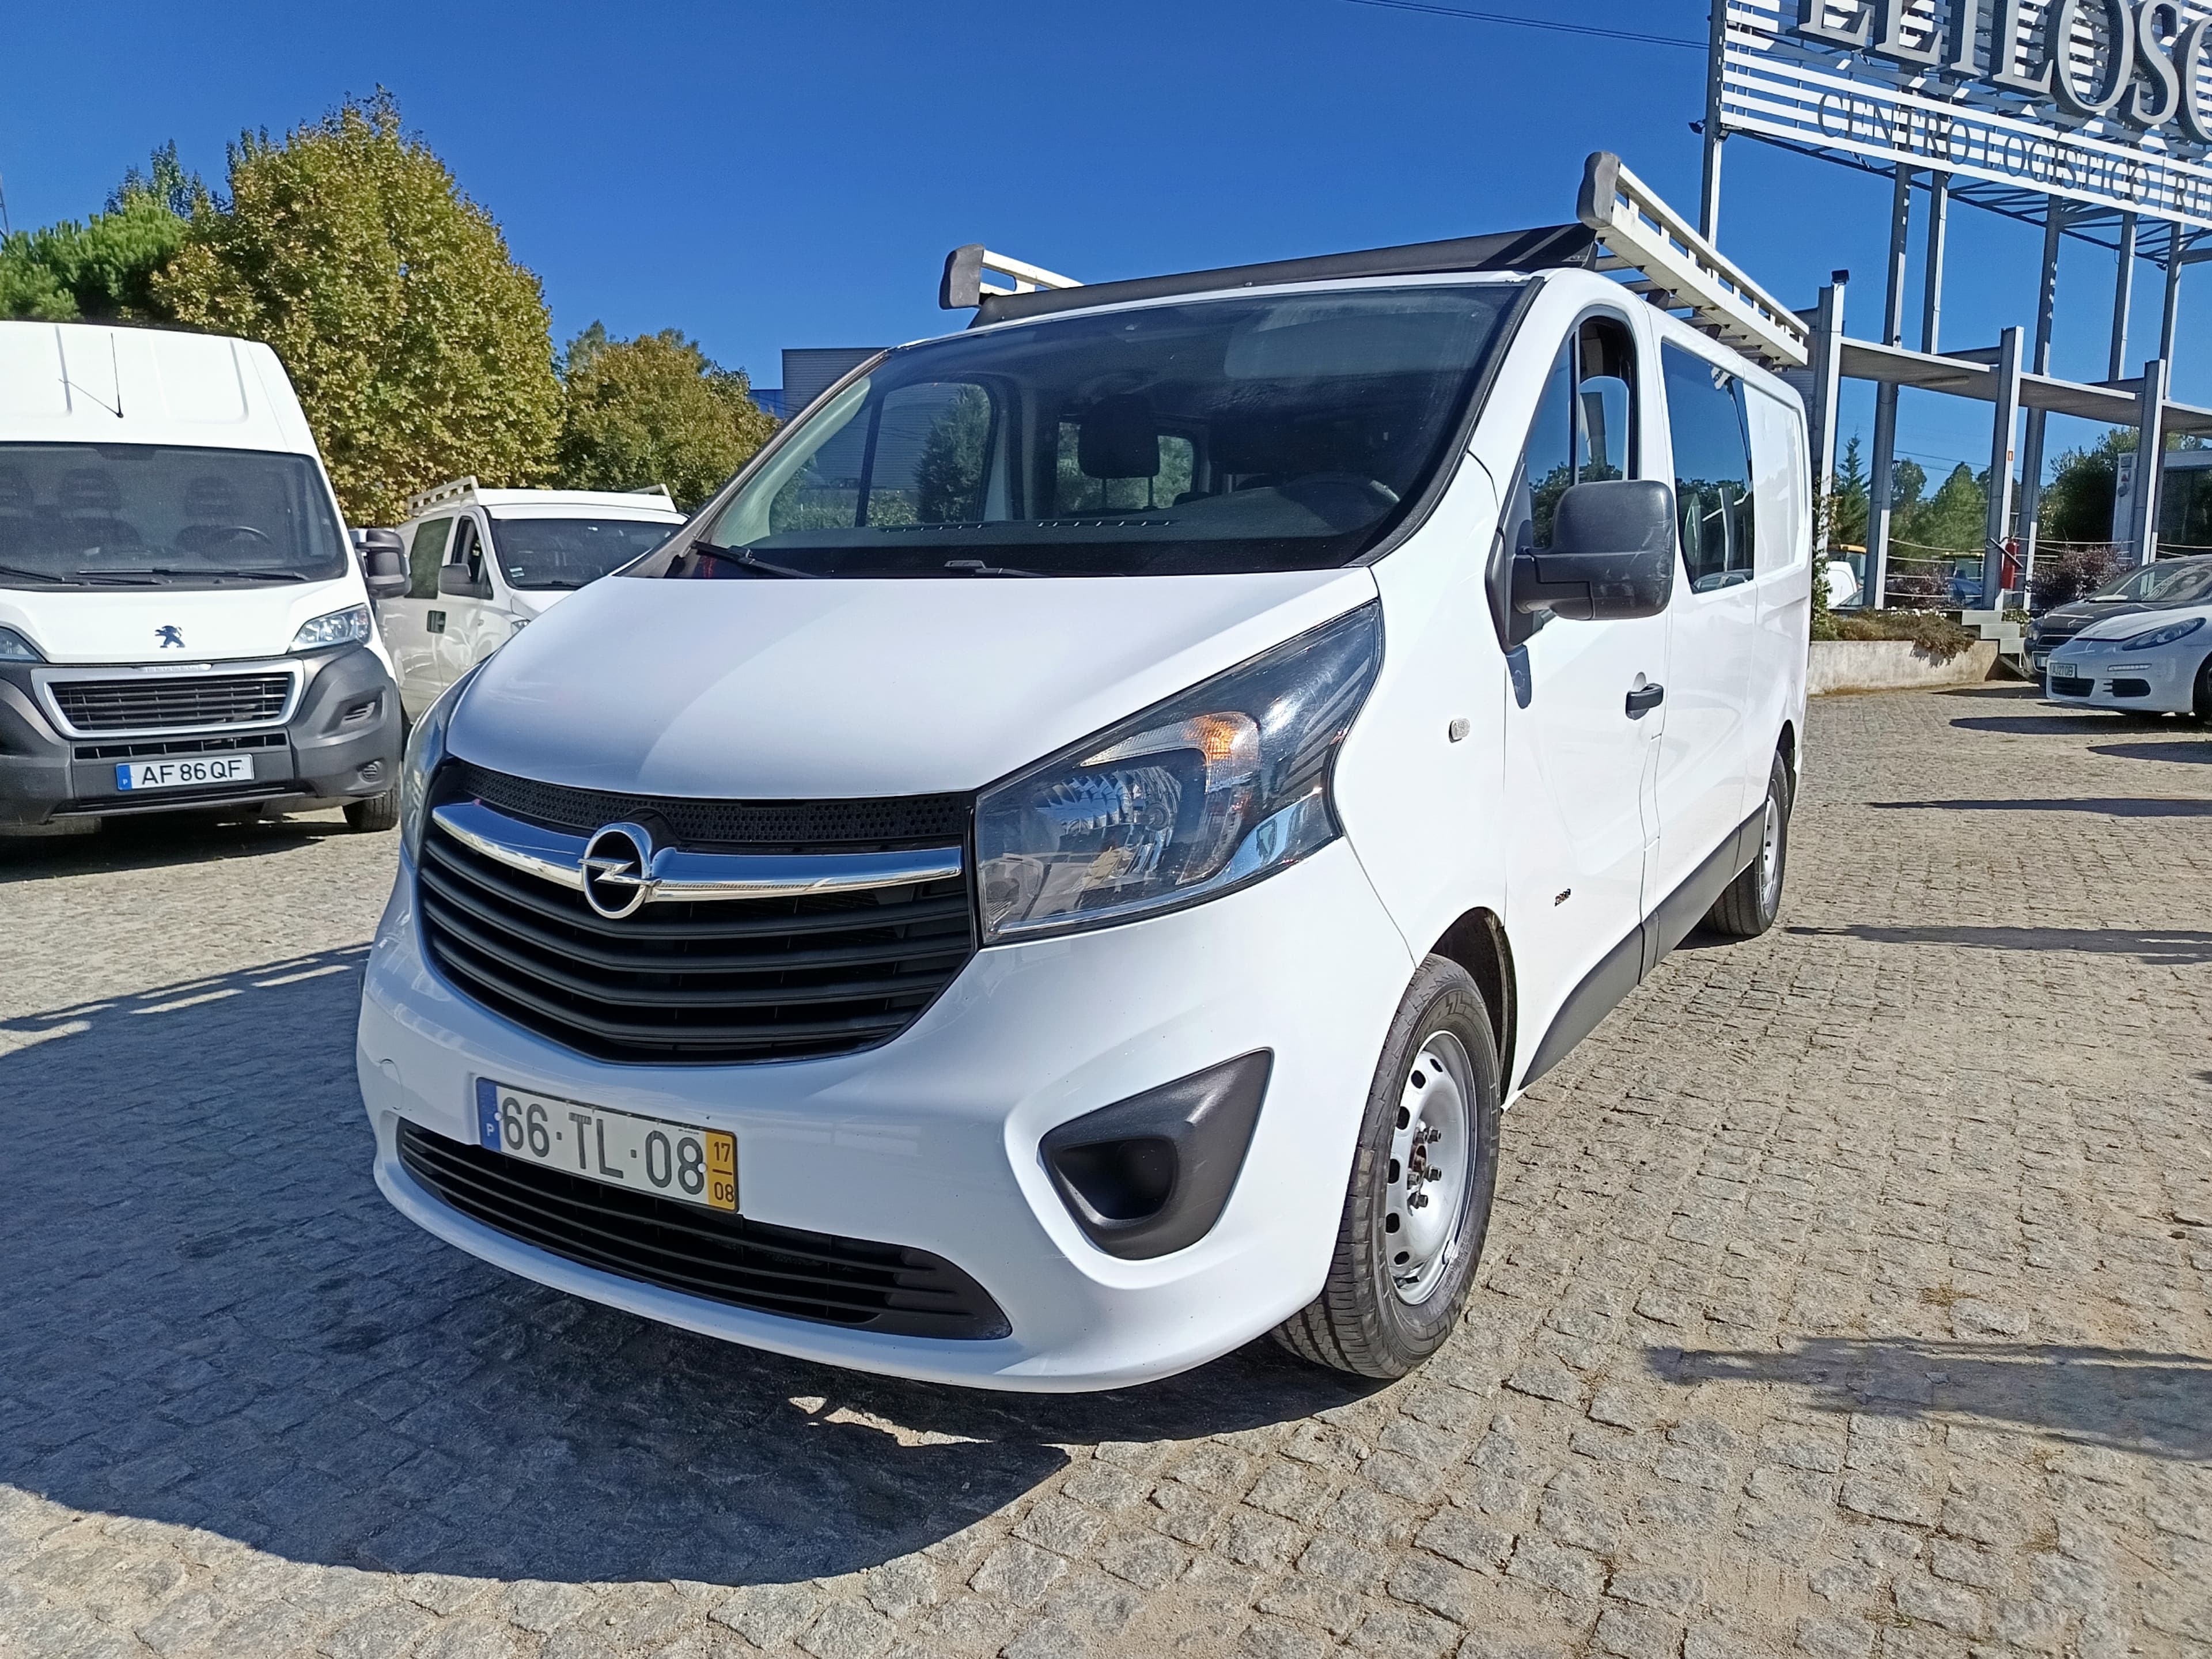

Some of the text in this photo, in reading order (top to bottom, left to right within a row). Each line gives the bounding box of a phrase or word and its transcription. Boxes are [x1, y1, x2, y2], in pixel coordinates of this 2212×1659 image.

[1817, 91, 1971, 165] CENTRO
[2174, 171, 2212, 221] RE
[142, 759, 242, 785] AF 86 QF
[486, 1123, 495, 1137] P
[714, 1141, 730, 1162] 17
[714, 1181, 734, 1203] 08
